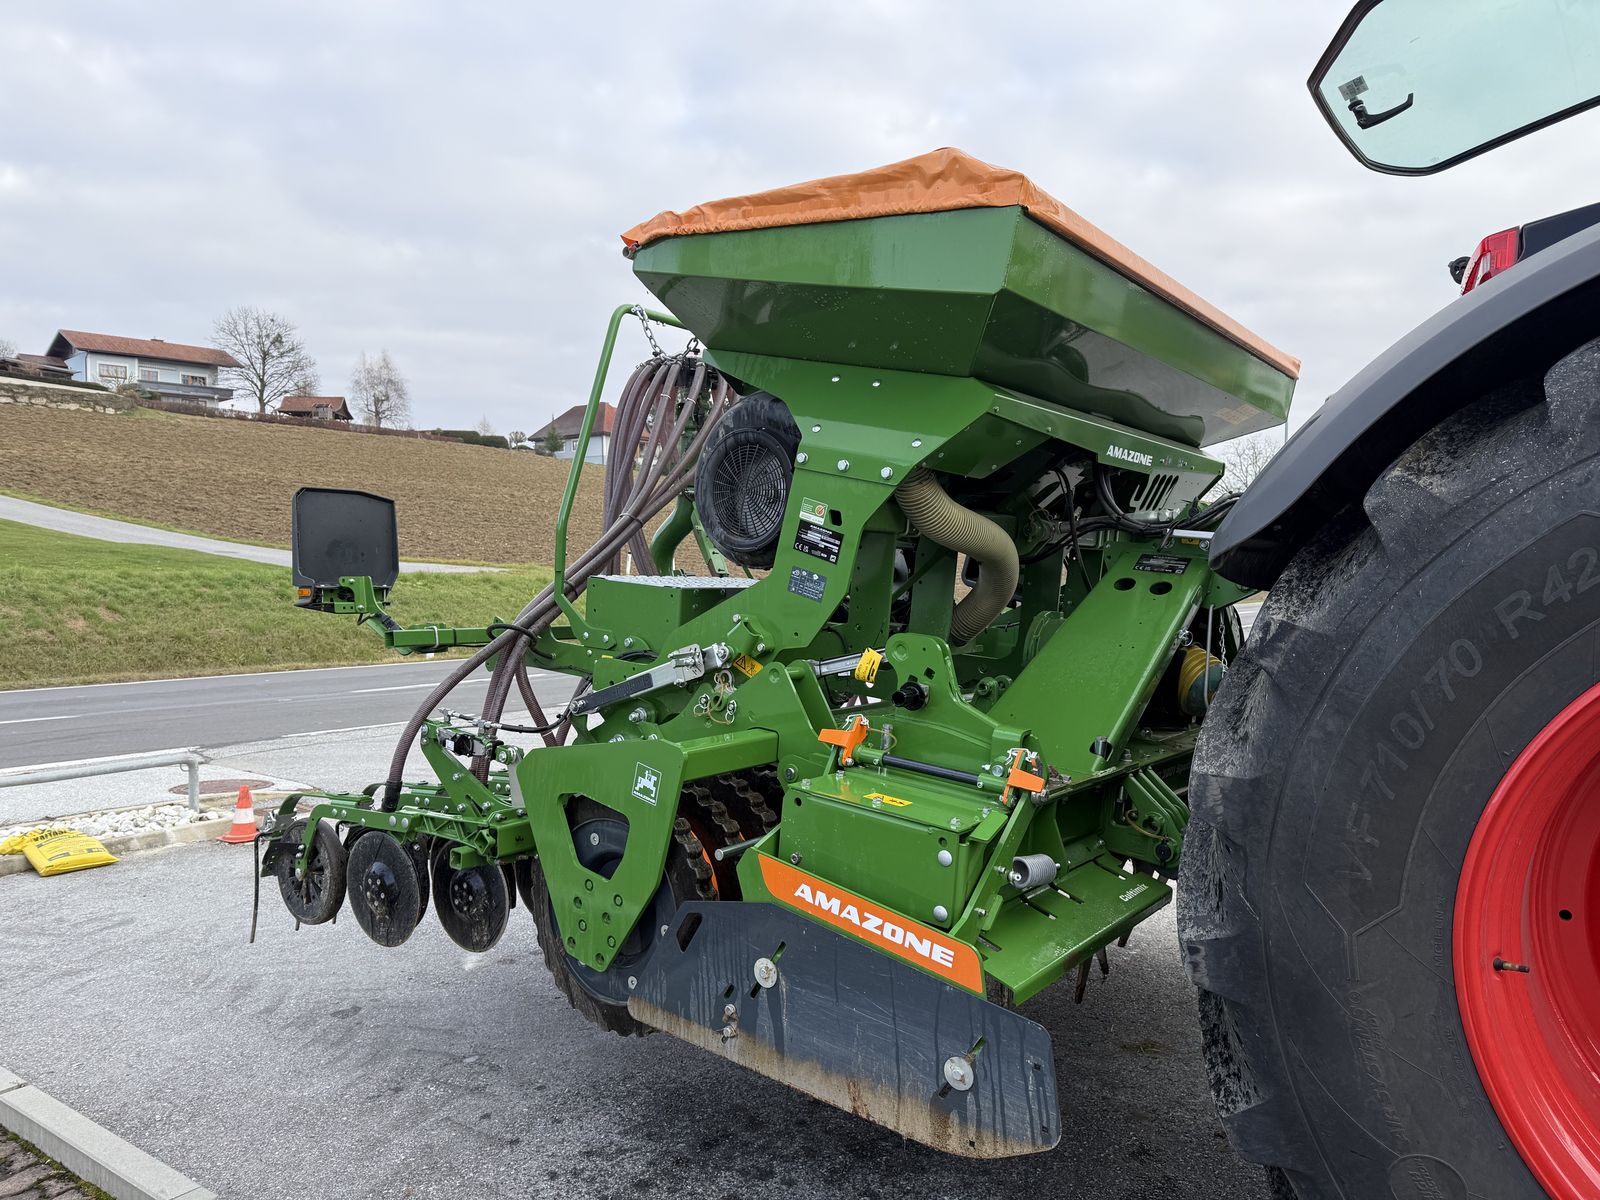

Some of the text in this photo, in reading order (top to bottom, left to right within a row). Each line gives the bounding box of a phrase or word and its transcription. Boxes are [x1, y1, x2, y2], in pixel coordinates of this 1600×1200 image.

[1106, 444, 1153, 466] AMAZONE
[1359, 637, 1484, 801] 710/70
[1119, 883, 1149, 902] Cultimix
[793, 883, 955, 968] AMAZONE
